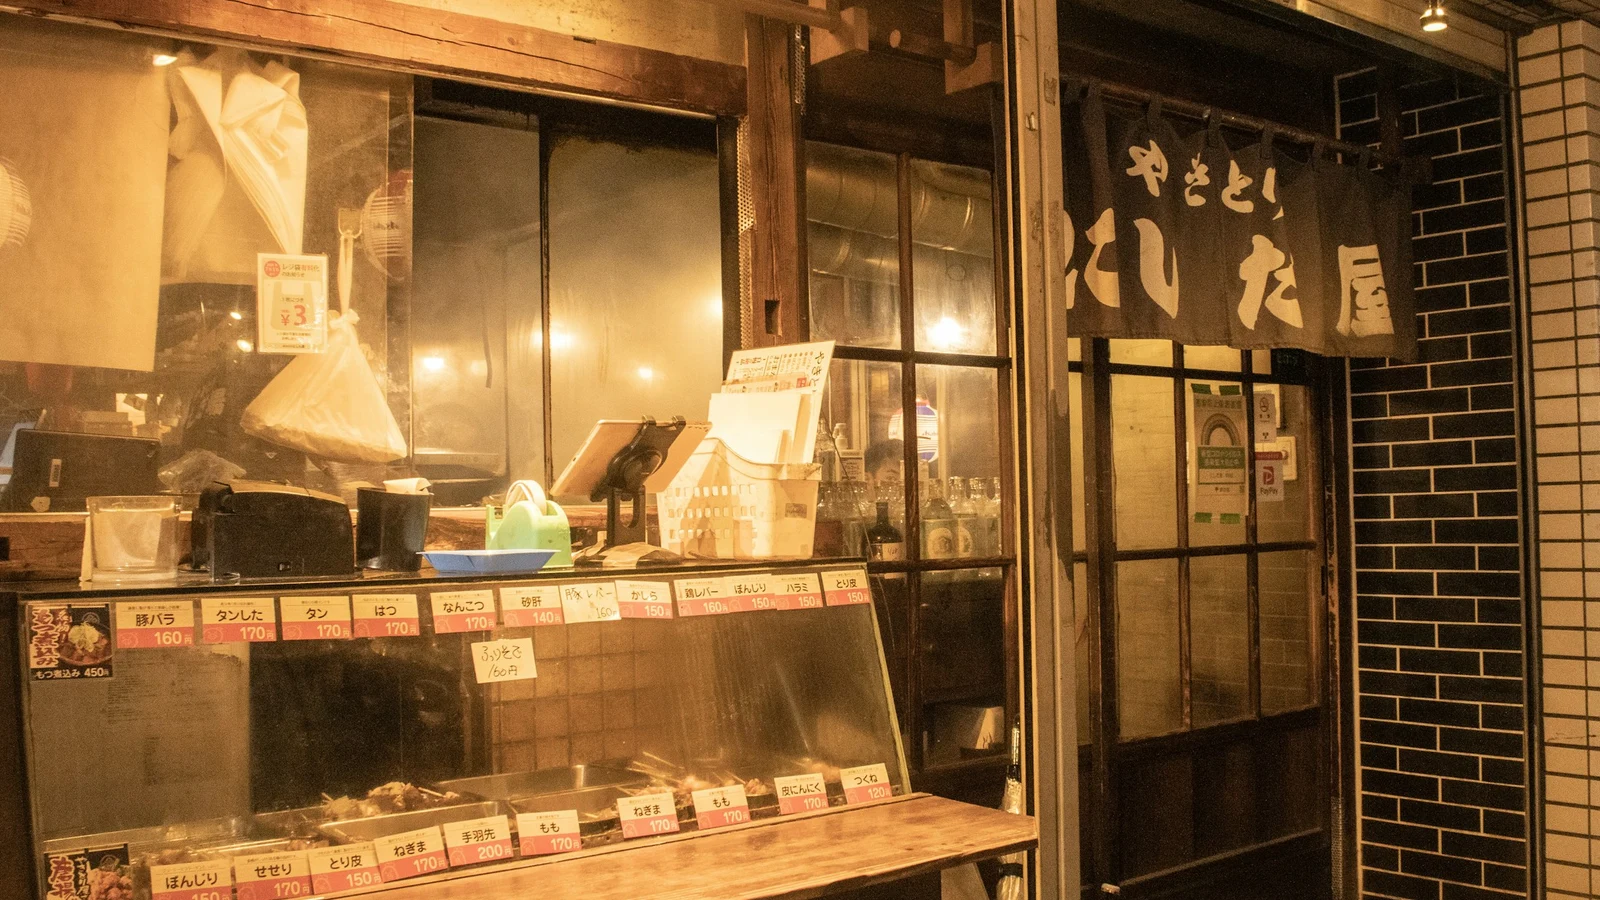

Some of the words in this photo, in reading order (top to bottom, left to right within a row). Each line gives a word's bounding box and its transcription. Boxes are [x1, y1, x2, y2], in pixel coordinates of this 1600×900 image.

[1260, 487, 1278, 497] PayPay
[787, 582, 809, 593] ハラミ
[836, 579, 858, 589] とり皮
[632, 590, 659, 601] かしら
[685, 588, 719, 599] 鶏レバー
[847, 591, 869, 603] 150円
[443, 601, 485, 613] なんこつ
[521, 596, 542, 608] 砂肝
[703, 601, 728, 613] 160円
[752, 597, 776, 609] 150円
[799, 596, 821, 607] 150円
[216, 609, 264, 622] タンした
[306, 608, 328, 620] タン
[374, 605, 397, 617] はつ
[533, 611, 562, 624] 140円
[644, 605, 672, 617] 150円
[136, 613, 175, 627] 豚バラ
[465, 616, 496, 630] 170円
[239, 626, 274, 640] 170円
[317, 624, 350, 638] 170円
[386, 621, 418, 635] 170円
[154, 631, 193, 645] 160円
[35, 669, 81, 680] もつ煮込み
[488, 664, 518, 679] 160円
[855, 773, 879, 786] つくね
[781, 783, 822, 797] 皮にんにく
[868, 786, 892, 799] 120円
[713, 796, 731, 808] もも
[804, 798, 828, 810] 170円
[634, 804, 662, 817] ねぎま
[723, 810, 750, 824] 170円
[540, 822, 561, 834] もも
[649, 819, 678, 832] 170円
[462, 829, 497, 843] 手羽先
[394, 843, 428, 857] ねぎま
[551, 837, 580, 850] 170円
[478, 846, 512, 860] 200円
[329, 856, 363, 870] とり皮
[413, 856, 446, 872] 170円
[254, 862, 292, 879] せせり
[165, 872, 218, 889] ぼんじり
[346, 872, 382, 888] 150円
[274, 880, 310, 897] 170円
